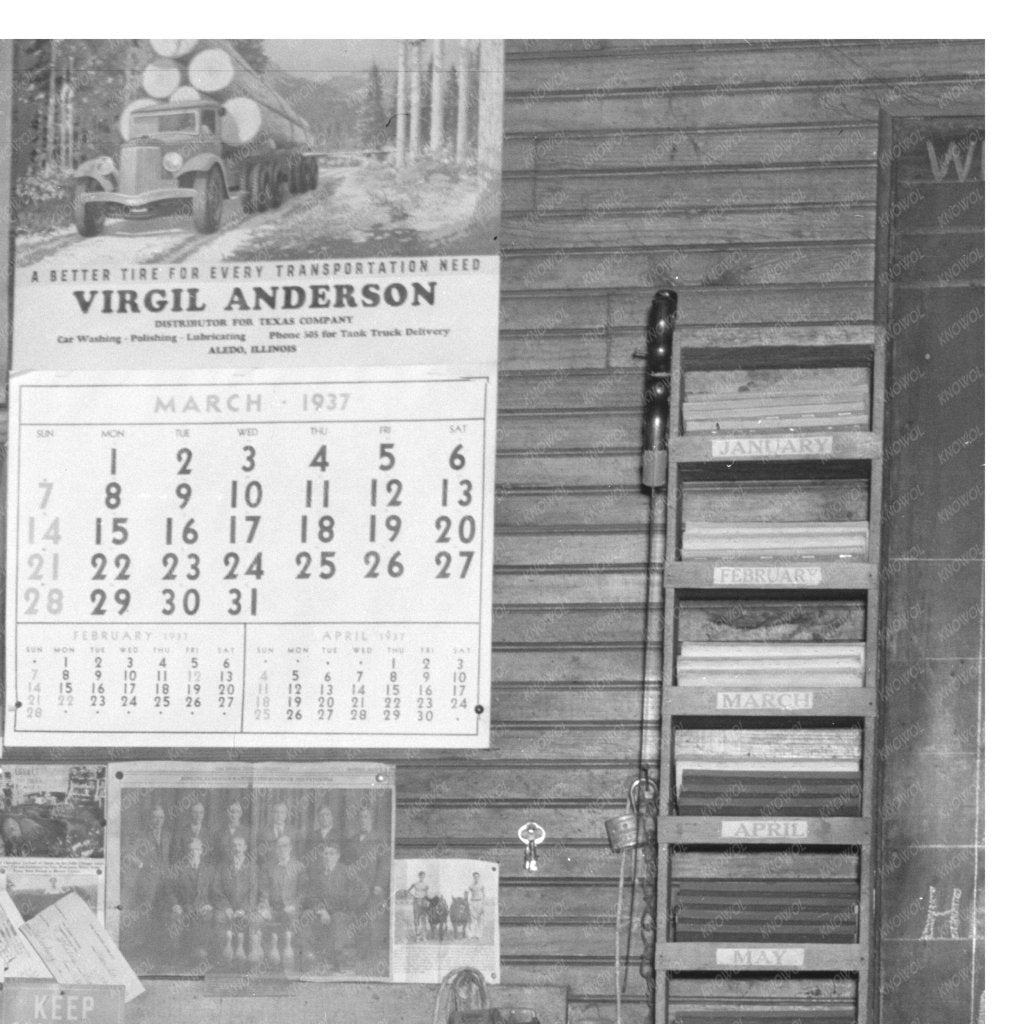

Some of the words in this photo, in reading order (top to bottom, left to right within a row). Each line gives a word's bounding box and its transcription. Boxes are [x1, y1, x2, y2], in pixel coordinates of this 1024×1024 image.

[927, 140, 985, 183] W
[32, 271, 38, 282] A
[50, 269, 110, 282] BETTER
[121, 268, 158, 280] TIRE
[169, 267, 199, 279] FOR
[210, 266, 263, 279] EVERY
[276, 260, 428, 277] TRANSPORTATION
[440, 259, 480, 271] NEED
[73, 288, 206, 313] VIRGIL
[225, 282, 437, 311] ANDERSON
[155, 319, 227, 328] DISTRIBUTOR
[232, 318, 253, 326] FOR
[299, 316, 352, 324] COMPANY
[77, 335, 121, 344] Washing
[131, 334, 177, 343] Polishing
[187, 333, 246, 342] Lubricating
[405, 328, 450, 337] Delivery
[209, 346, 246, 354] ALEDO,
[251, 345, 296, 353] ILLINOIS
[154, 394, 261, 413] MARCH
[303, 393, 350, 411] 1937
[102, 430, 124, 438] MON
[176, 429, 189, 437] TUE
[238, 428, 257, 436] WED
[310, 427, 327, 435] THU
[450, 425, 466, 433] SAT
[719, 438, 829, 456] JANUARY
[111, 448, 116, 475] 1
[177, 448, 192, 475] 2
[242, 446, 256, 472] 3
[310, 445, 329, 472] 4
[379, 443, 395, 471] 5
[449, 444, 465, 470] 6
[39, 479, 53, 509] 7
[105, 482, 121, 509] 8
[176, 483, 192, 509] 9
[231, 481, 262, 508] 10
[306, 480, 329, 508] 11
[371, 479, 402, 506] 12
[442, 479, 472, 506] 13
[29, 517, 62, 545] 14
[96, 518, 128, 545] 15
[166, 518, 198, 545] 16
[230, 516, 261, 544] 17
[301, 515, 335, 543] 18
[370, 515, 401, 542] 19
[435, 515, 475, 544] 20
[28, 553, 59, 580] 21
[91, 553, 130, 580] 22
[162, 553, 200, 580] 23
[224, 552, 264, 579] 24
[296, 552, 336, 579] 25
[364, 551, 404, 578] 26
[435, 551, 474, 578] 27
[720, 568, 819, 583] FEBRUARY
[24, 587, 64, 615] 28
[90, 589, 131, 615] 29
[162, 589, 200, 615] 30
[228, 588, 257, 615] 31
[74, 631, 151, 641] FEBRUARY
[323, 631, 368, 641] APRIL
[722, 693, 810, 708] MARCH
[734, 823, 805, 837] APRIL
[733, 952, 787, 965] MAY
[33, 994, 94, 1020] KEEP
